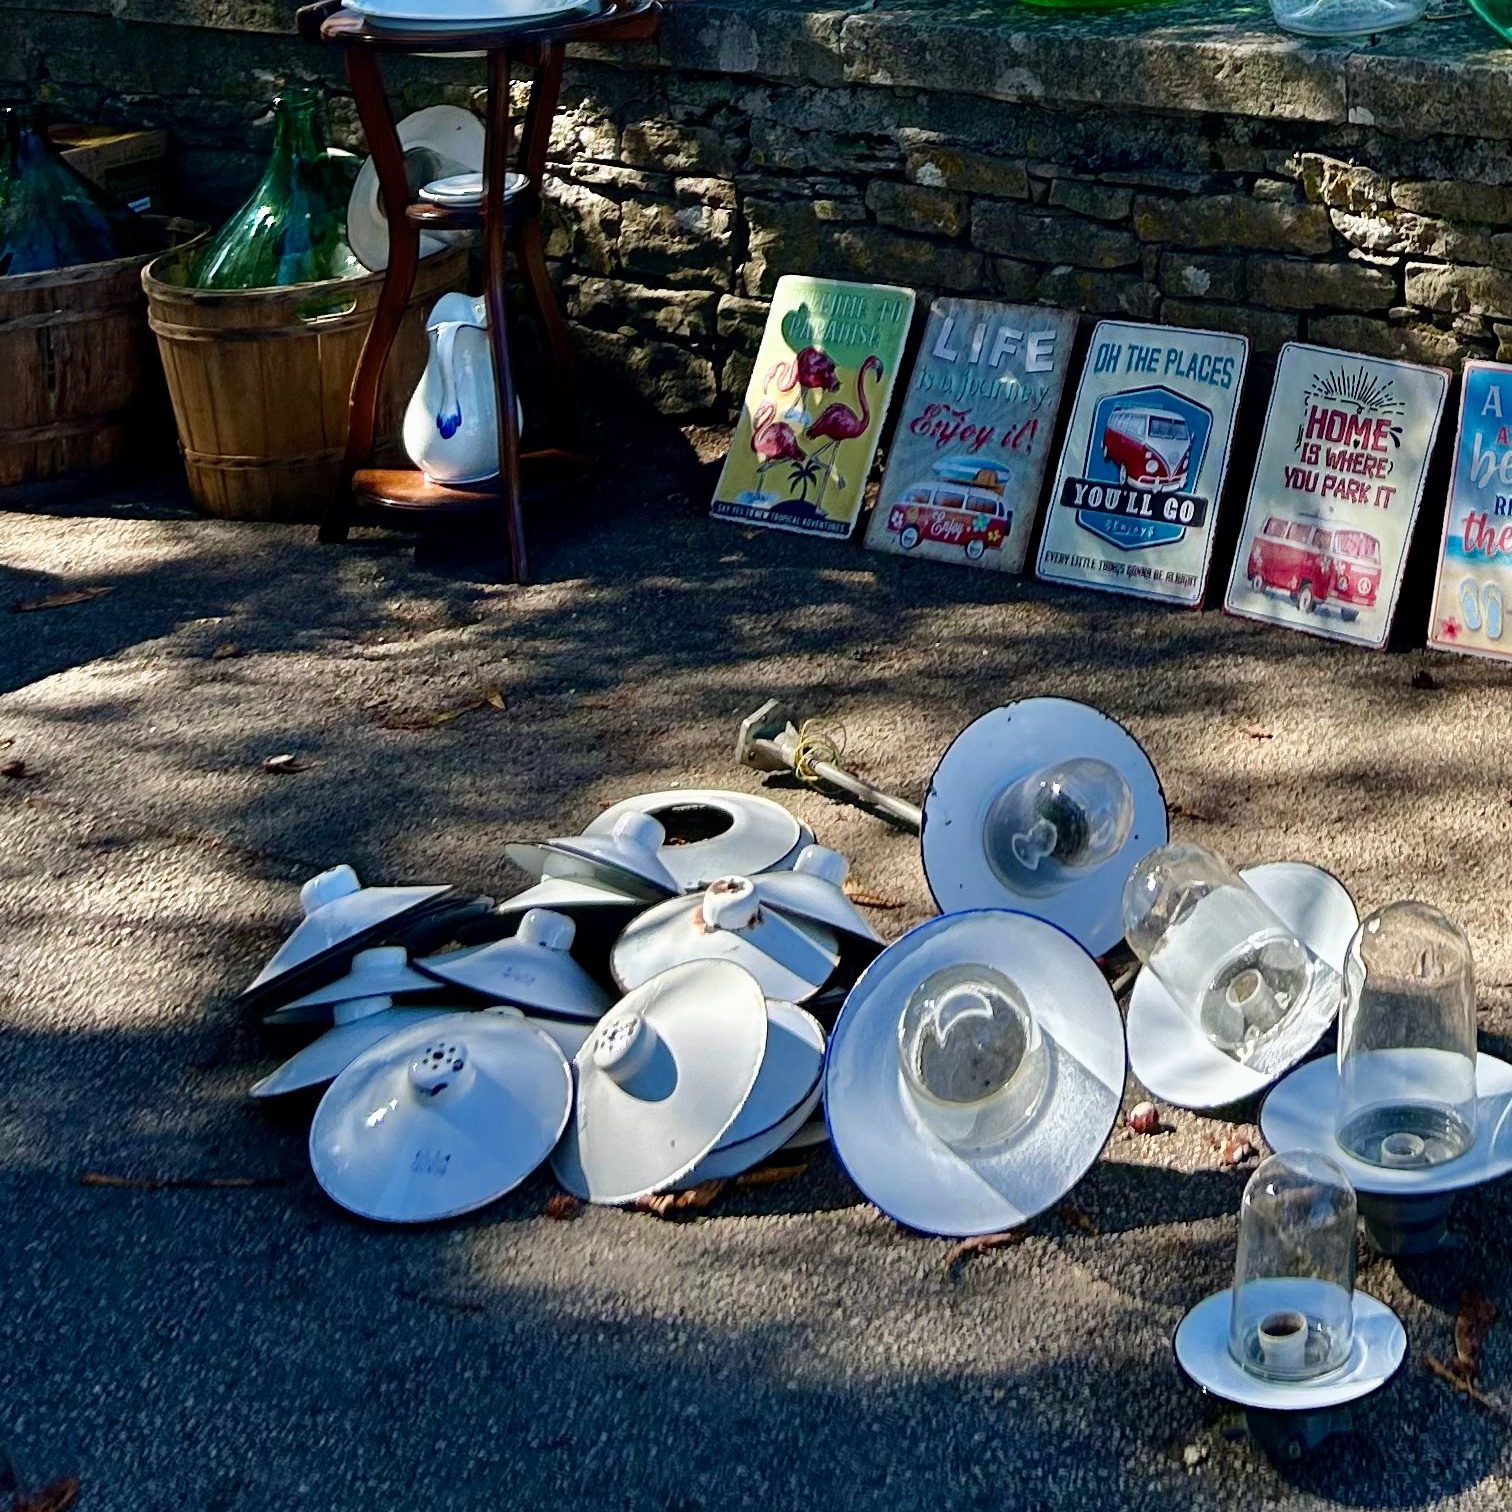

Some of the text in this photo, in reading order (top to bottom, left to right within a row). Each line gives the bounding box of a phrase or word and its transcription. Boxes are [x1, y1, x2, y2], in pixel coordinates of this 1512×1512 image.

[788, 315, 880, 347] PARADISE
[932, 316, 1057, 373] LIFE
[1094, 343, 1235, 389] OH THE PLACES
[1481, 386, 1503, 418] A
[910, 403, 1039, 454] Enjoy it!
[1305, 405, 1392, 453] HOME
[1300, 442, 1389, 479] IS WHERE
[1073, 483, 1195, 523] YOU'LL GO
[1284, 466, 1397, 509] YOU PARK IT
[930, 511, 965, 541] Enjoy
